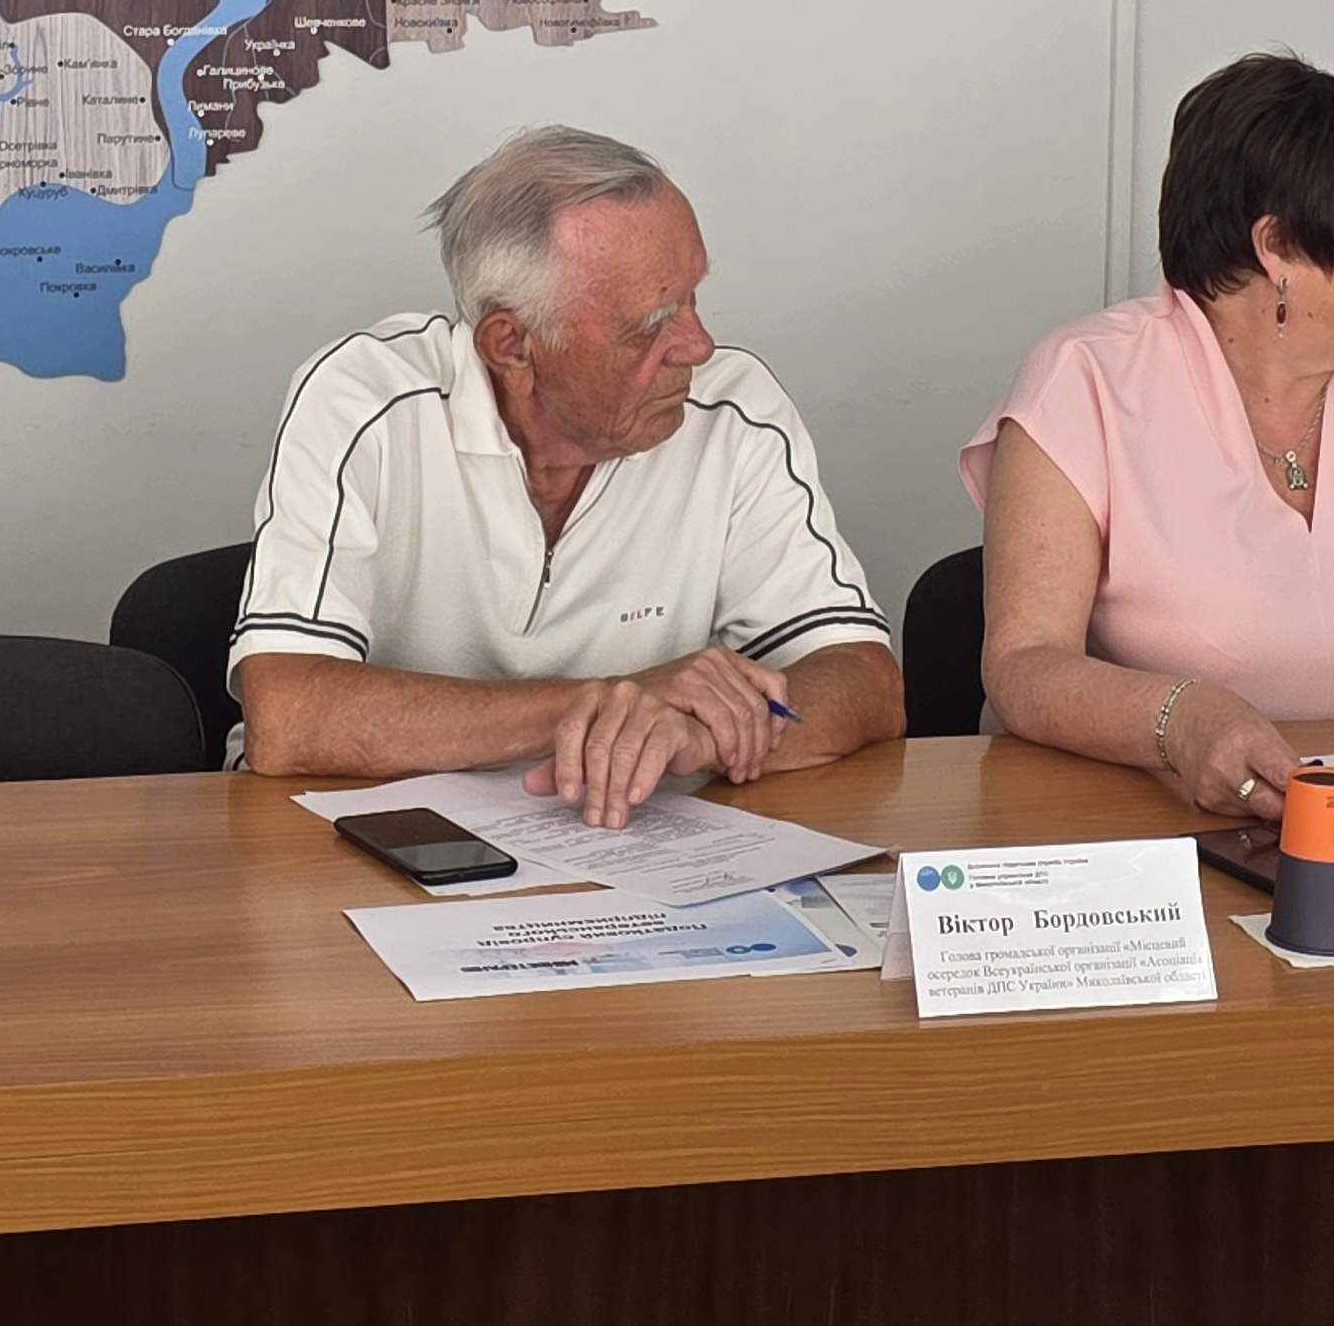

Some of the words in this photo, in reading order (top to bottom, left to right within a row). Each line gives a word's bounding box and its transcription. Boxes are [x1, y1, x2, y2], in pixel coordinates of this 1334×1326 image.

[124, 24, 159, 38] Стара
[938, 915, 1014, 935] Віктор
[1034, 902, 1181, 932] Бордовський
[940, 950, 981, 963] Голова
[985, 946, 1055, 963] громадської
[1058, 942, 1120, 958] організації
[928, 966, 979, 982] осередок
[983, 960, 1071, 978] Всеукраїнської
[1075, 958, 1136, 975] організації
[929, 984, 984, 998] ветеранів
[988, 981, 1015, 994] ДПС
[1076, 974, 1161, 989] Миколаївської
[1165, 971, 1205, 983] області
